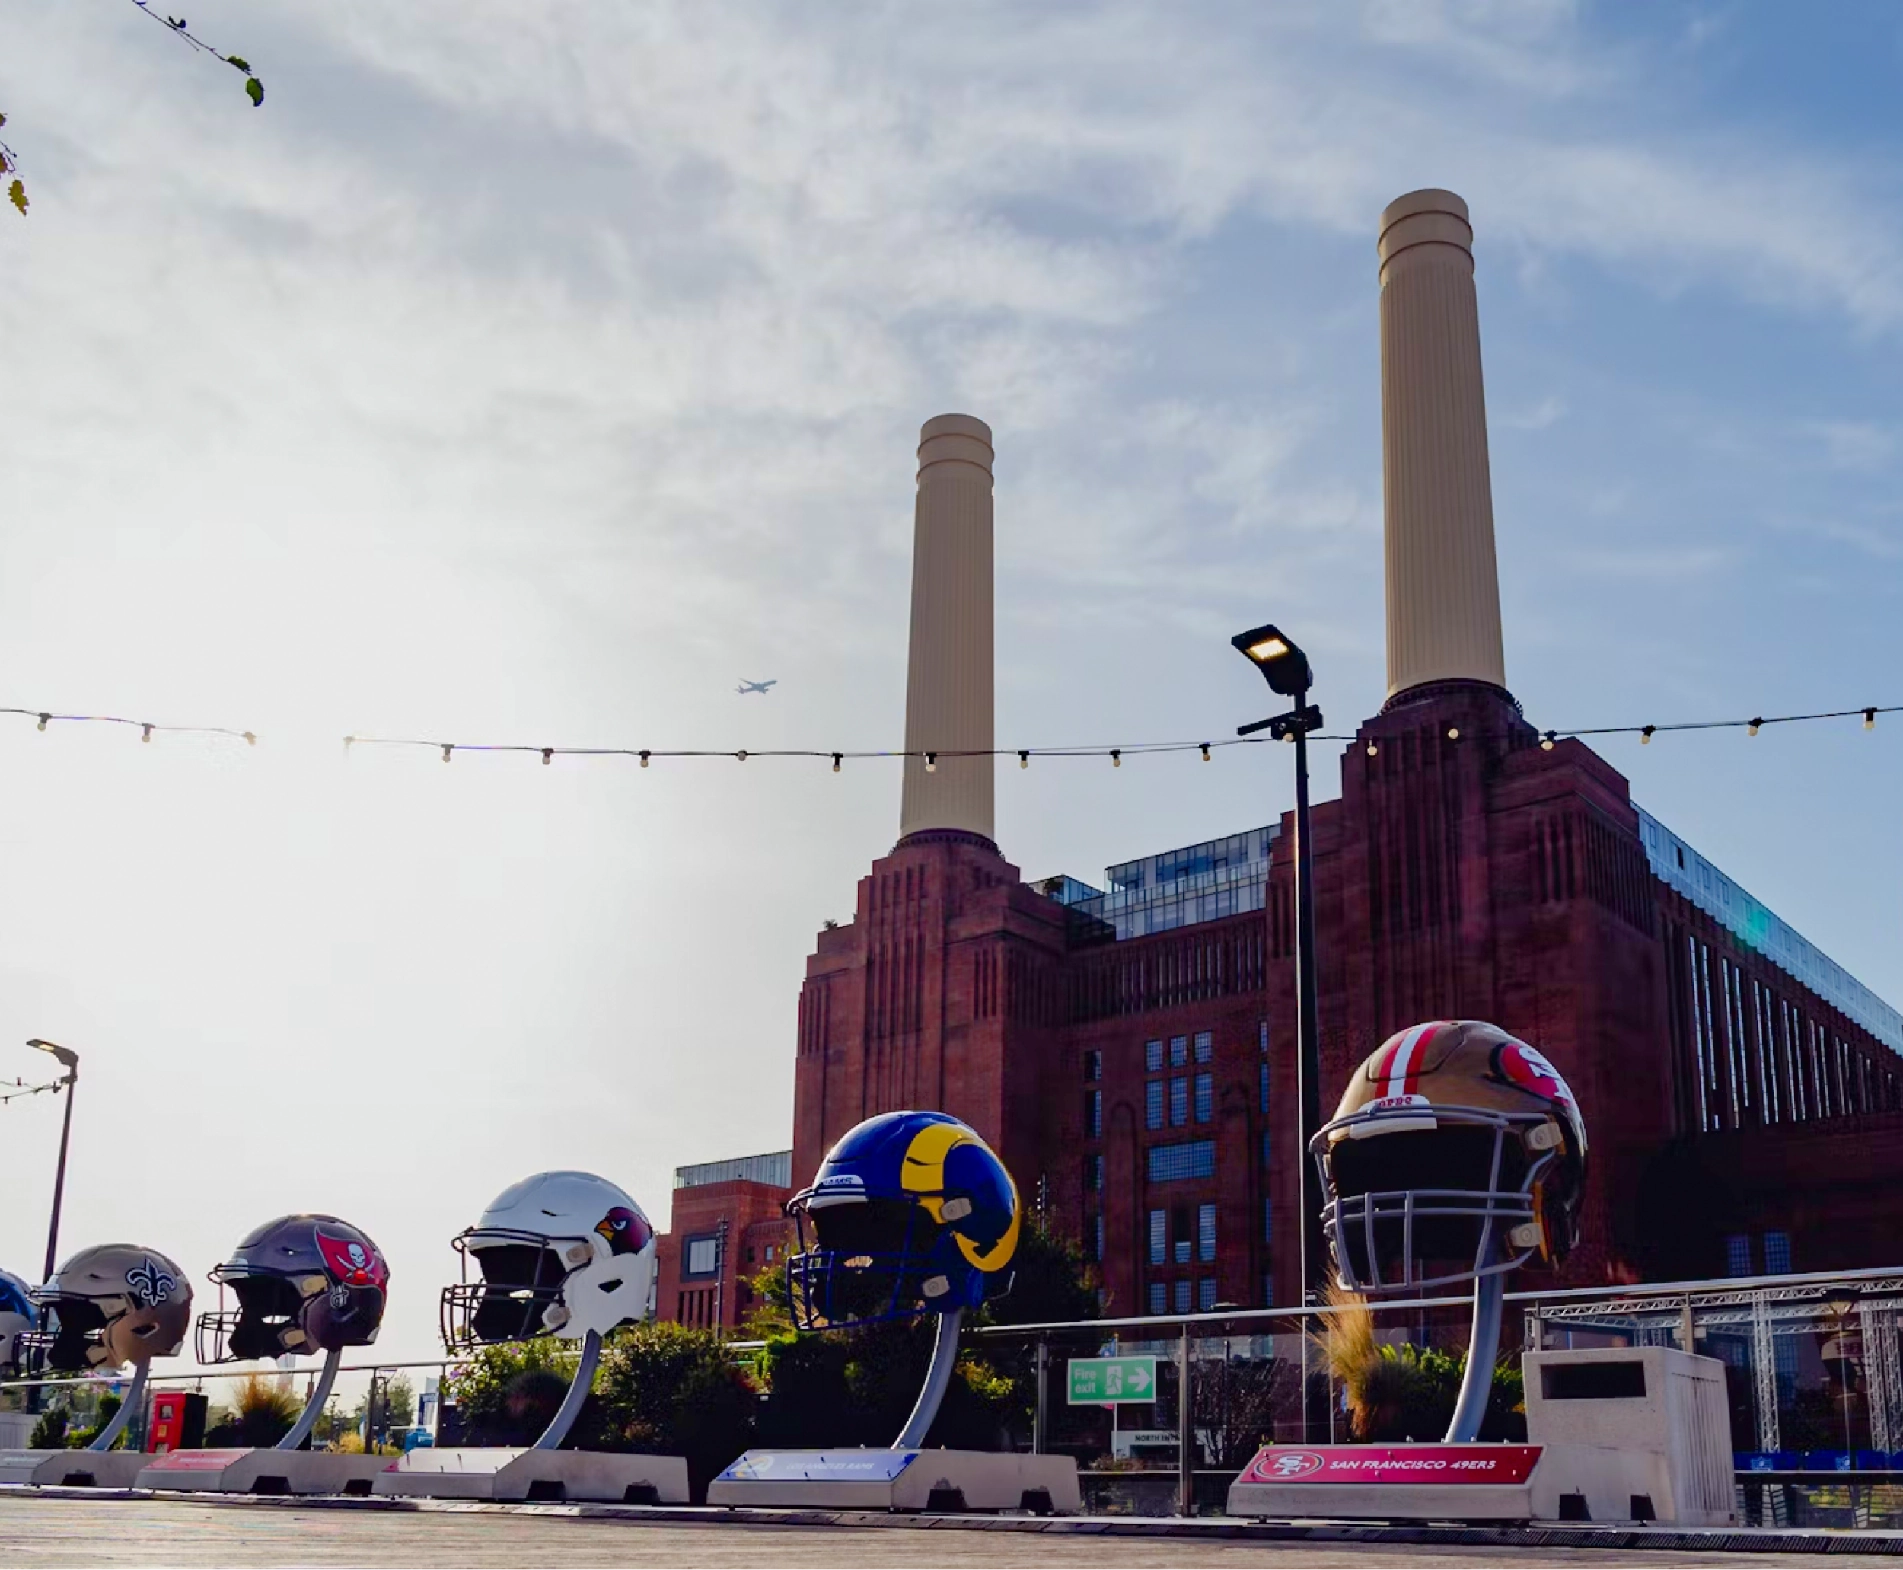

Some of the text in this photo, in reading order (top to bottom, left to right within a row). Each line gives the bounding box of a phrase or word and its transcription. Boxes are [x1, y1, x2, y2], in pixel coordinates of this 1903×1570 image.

[1074, 1368, 1097, 1380] Fire
[1075, 1382, 1096, 1394] exit
[1135, 1434, 1160, 1442] NORTH
[1329, 1460, 1497, 1470] SAN FRANCISCO 49ERS
